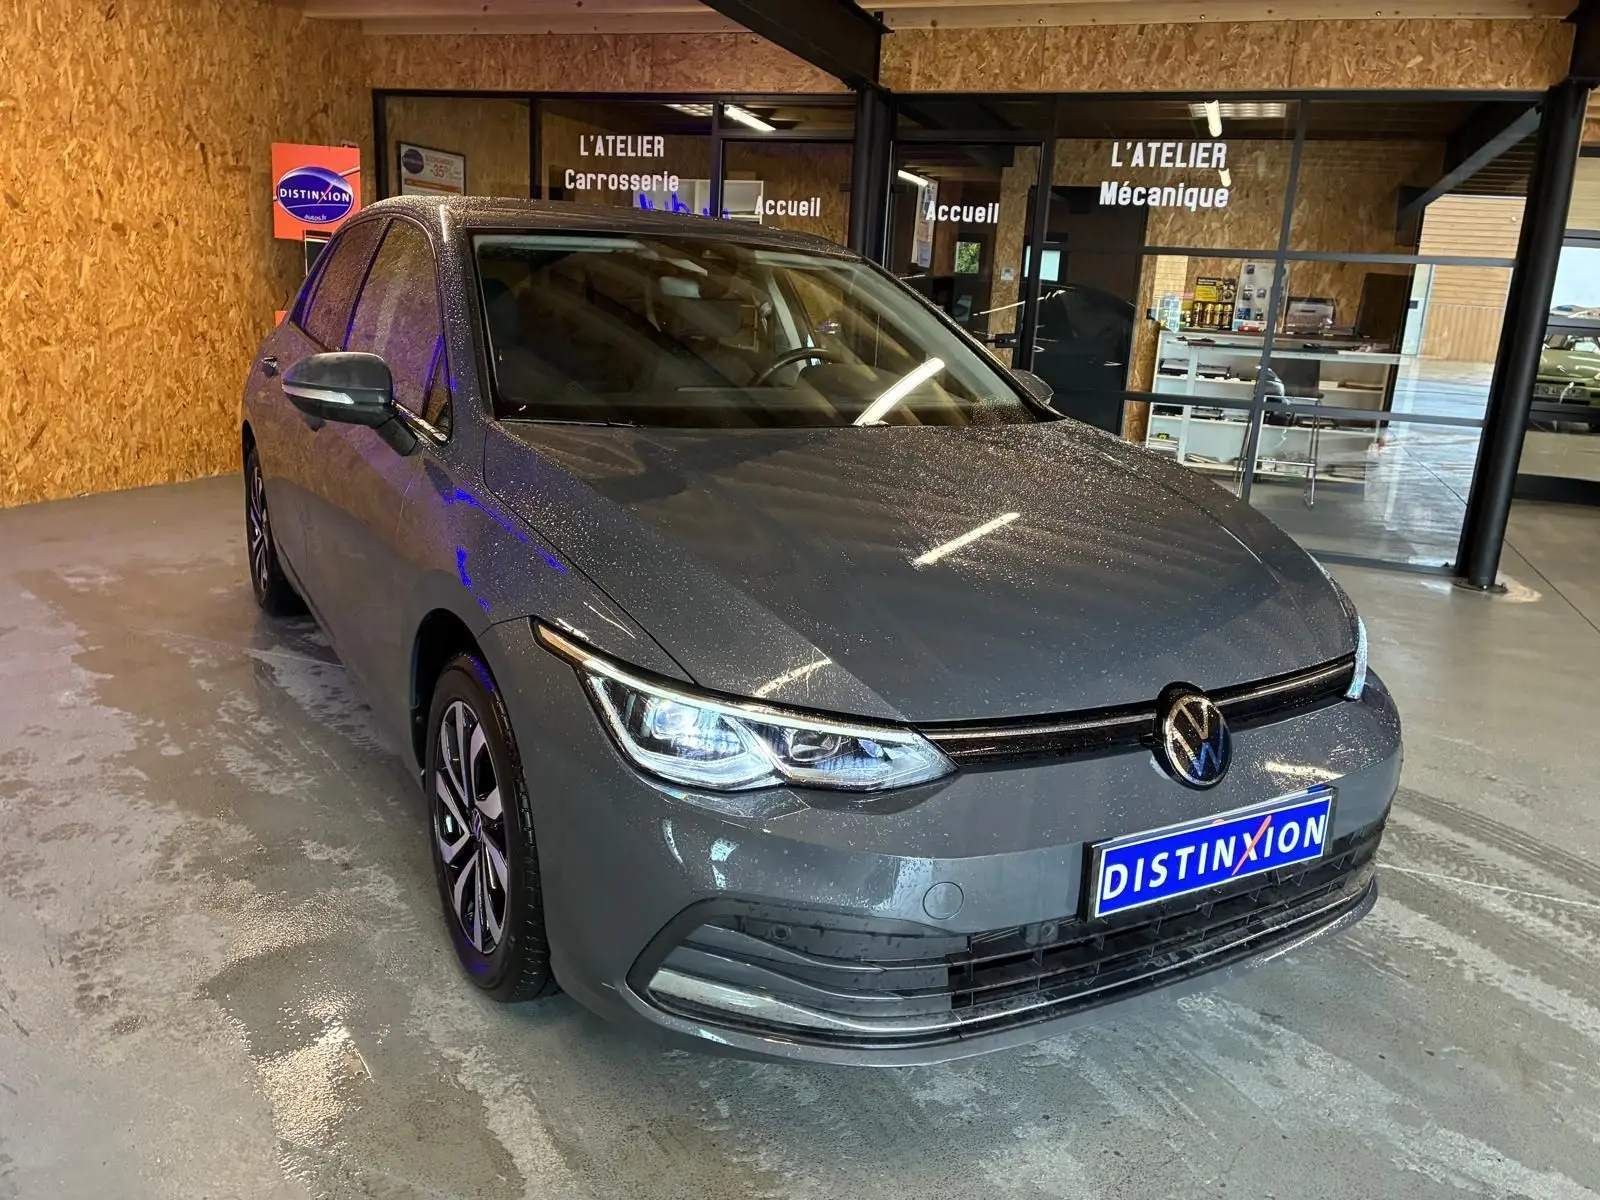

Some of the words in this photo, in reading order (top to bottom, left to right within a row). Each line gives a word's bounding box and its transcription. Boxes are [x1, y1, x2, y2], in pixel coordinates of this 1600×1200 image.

[580, 135, 664, 157] L'ATELIER
[1111, 142, 1227, 168] L'ATELIER
[565, 170, 679, 192] Carrosserie
[279, 187, 350, 203] DISTINXION
[1099, 181, 1229, 212] Mécanique
[755, 196, 820, 217] Accueil
[925, 201, 999, 223] Accueil
[1102, 813, 1326, 901] DISTINXION
